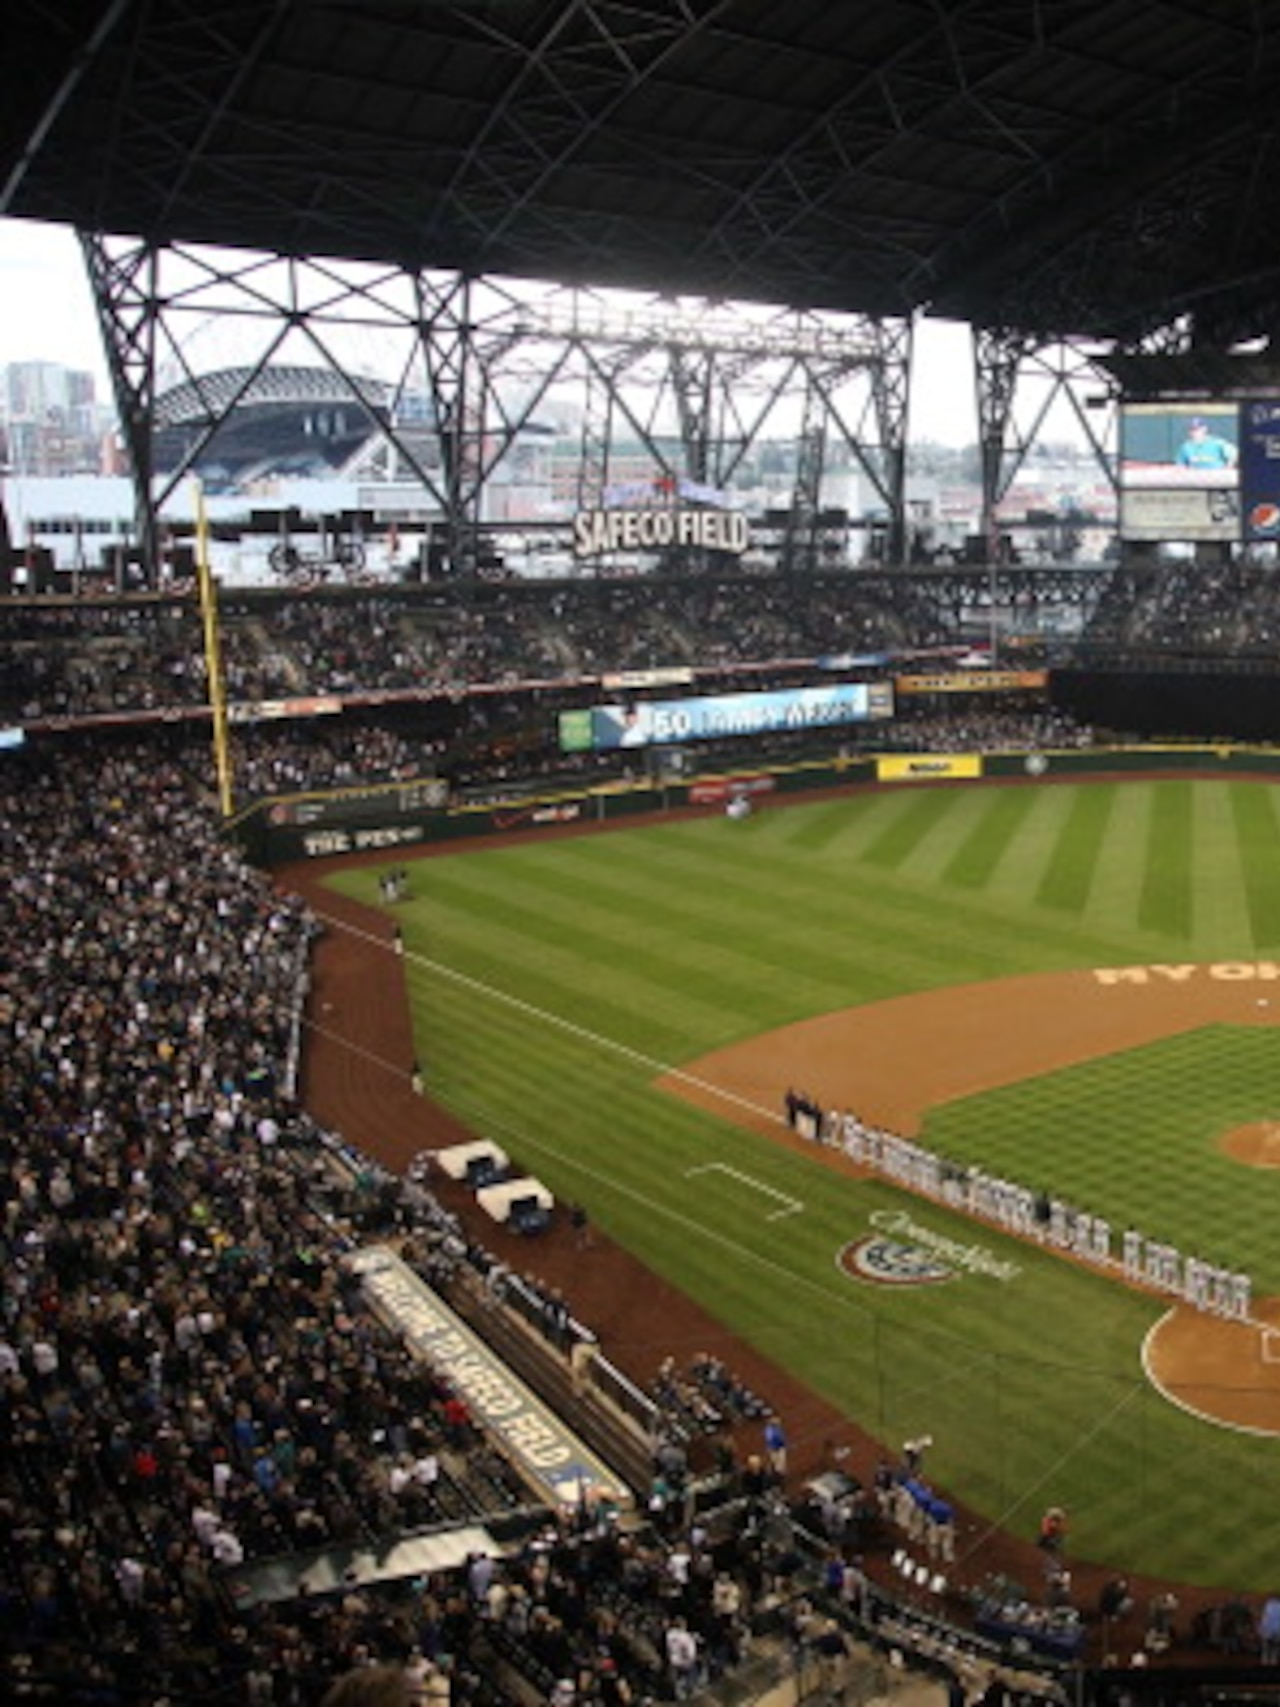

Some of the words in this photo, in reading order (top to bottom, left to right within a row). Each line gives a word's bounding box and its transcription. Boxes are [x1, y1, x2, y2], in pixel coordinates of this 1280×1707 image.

[574, 511, 674, 556] SAFECO
[679, 511, 748, 553] FIELD
[303, 833, 350, 857] THE
[1094, 963, 1197, 984] MY
[497, 1411, 571, 1467] FIELD
